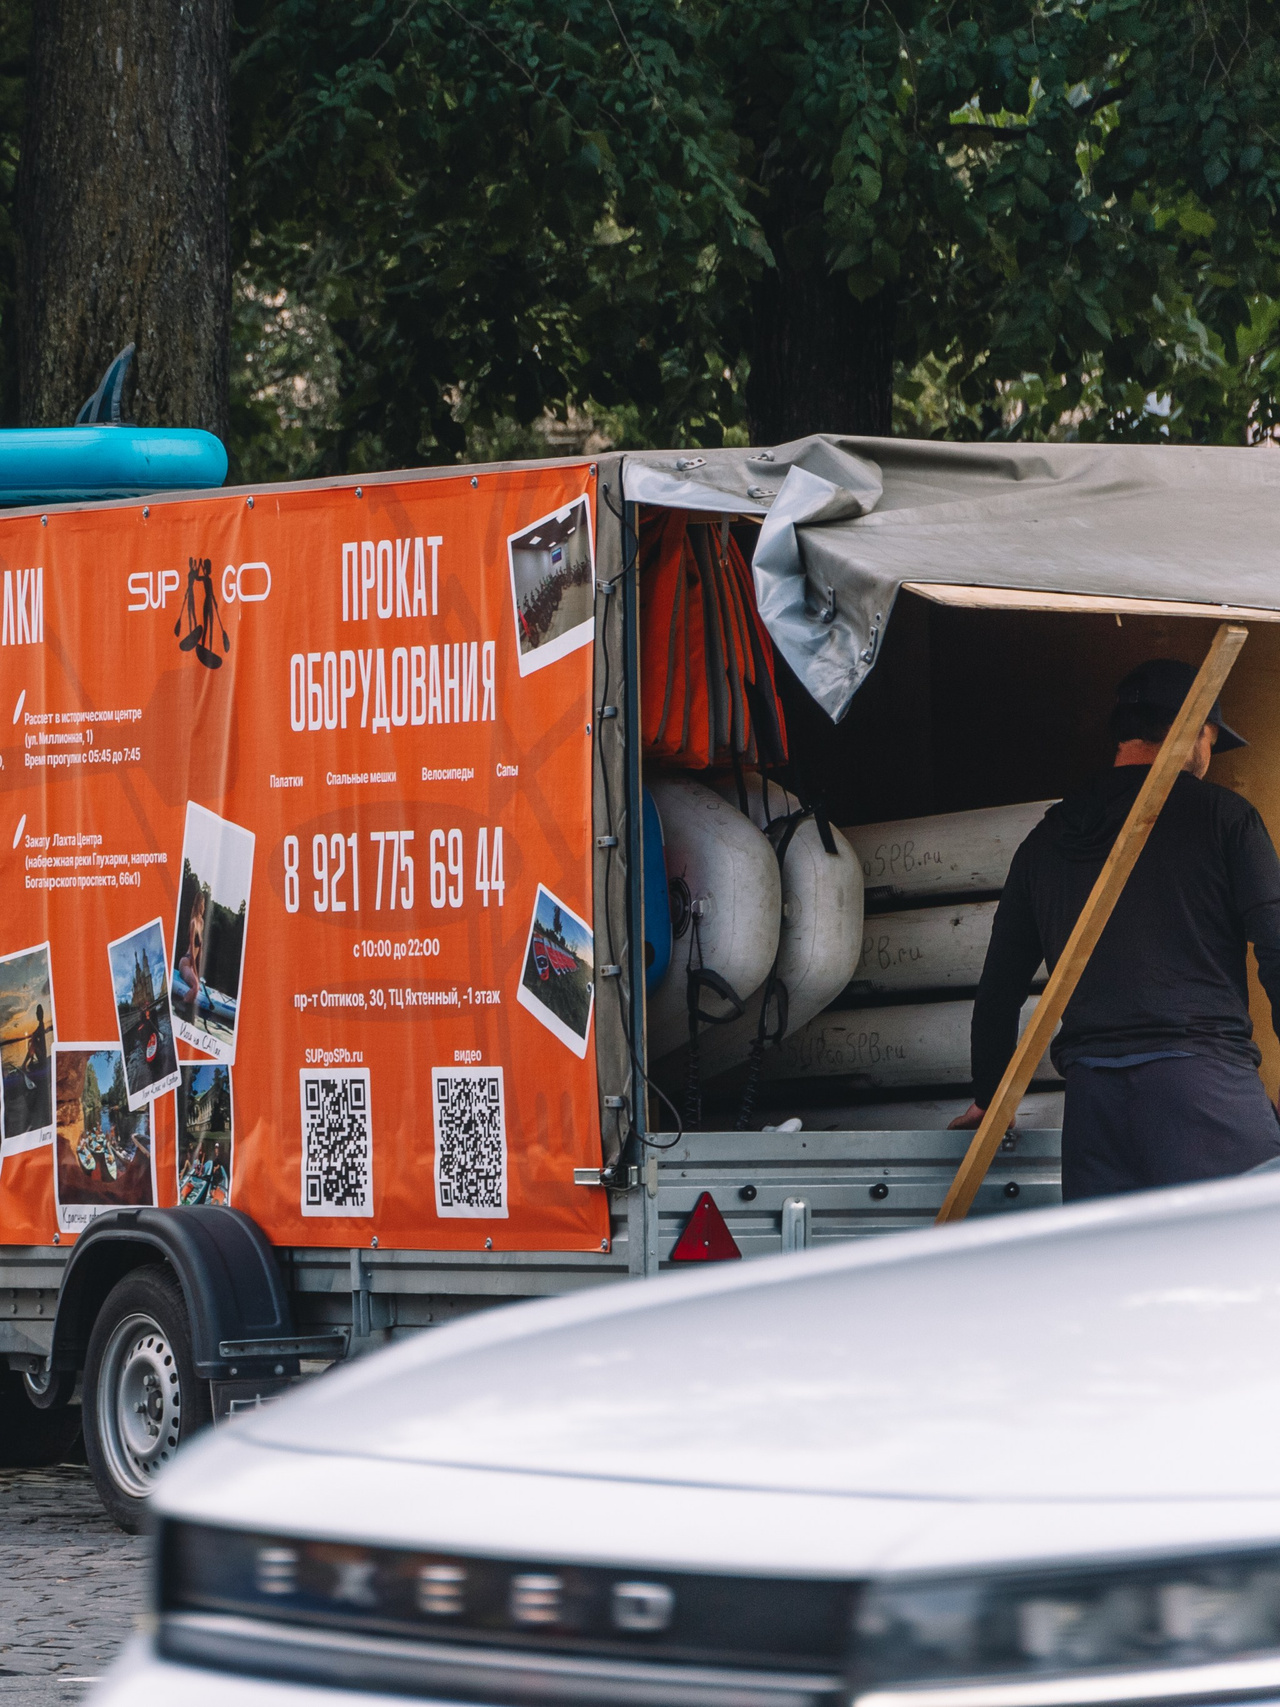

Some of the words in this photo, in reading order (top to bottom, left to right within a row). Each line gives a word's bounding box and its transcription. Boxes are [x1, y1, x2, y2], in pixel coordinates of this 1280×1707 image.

[127, 569, 180, 611] SUP
[221, 562, 271, 604] GO
[342, 535, 443, 622] ПРОКАТ
[290, 641, 496, 734] ОБОРУДОВАНИЯ
[55, 714, 60, 724] в
[61, 711, 114, 725] историческом
[114, 708, 142, 723] центре
[38, 731, 85, 746] Миллионная,
[86, 729, 94, 745] 1)
[24, 753, 46, 769] Время
[82, 754, 87, 764] с
[88, 748, 111, 763] 05:45
[112, 751, 123, 764] до
[123, 747, 141, 761] 7:45
[326, 771, 369, 785] Спальные
[370, 770, 396, 783] мешки
[421, 766, 474, 781] Велосипеды
[496, 762, 518, 777] Сапы
[270, 774, 304, 788] Палатки
[52, 833, 76, 847] Лахта
[76, 832, 102, 848] Центра
[74, 855, 91, 869] реки
[92, 851, 130, 868] Глухарки,
[131, 852, 168, 867] напротив
[284, 835, 300, 913] 8
[312, 832, 359, 913] 921
[370, 830, 414, 911] 775
[429, 828, 464, 909] 69
[475, 826, 505, 907] 44
[77, 874, 118, 890] проспекта,
[119, 871, 141, 887] 66к1)
[353, 942, 360, 957] с
[361, 939, 392, 957] 10:00
[393, 942, 406, 960] до
[407, 938, 440, 957] 22:00
[294, 992, 318, 1011] пр-т
[320, 989, 368, 1010] Оптиков,
[369, 988, 387, 1009] 30,
[388, 988, 404, 1009] ТЦ
[405, 987, 461, 1007] Яхтенный,
[462, 987, 473, 1005] -1
[474, 989, 501, 1005] этаж
[305, 1048, 363, 1066] SUPgoSPb.ru
[453, 1050, 482, 1064] видео
[257, 1546, 674, 1631] EXEED
